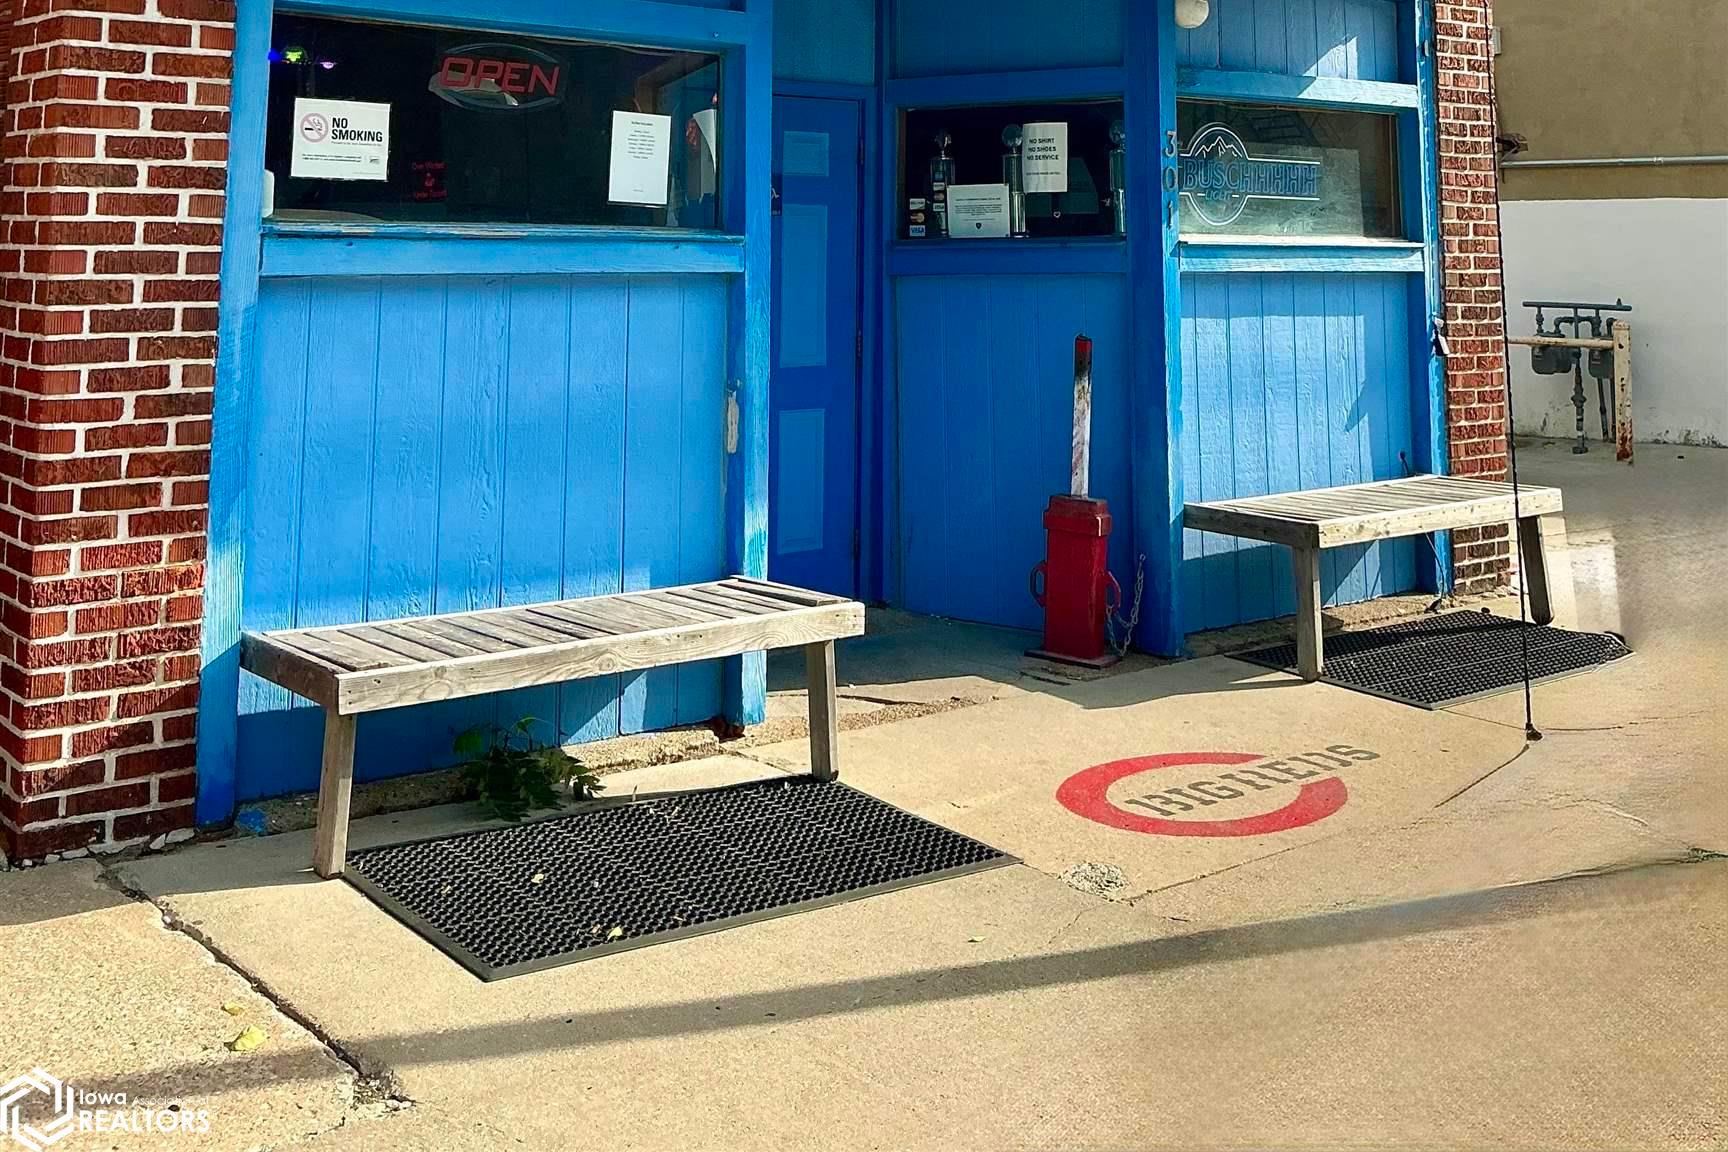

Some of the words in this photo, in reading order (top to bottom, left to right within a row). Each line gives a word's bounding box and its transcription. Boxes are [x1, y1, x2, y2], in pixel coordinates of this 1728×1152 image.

[441, 56, 560, 97] OPEN
[331, 128, 383, 143] SMOKING
[332, 117, 348, 129] NO
[1123, 780, 1245, 817] BIG
